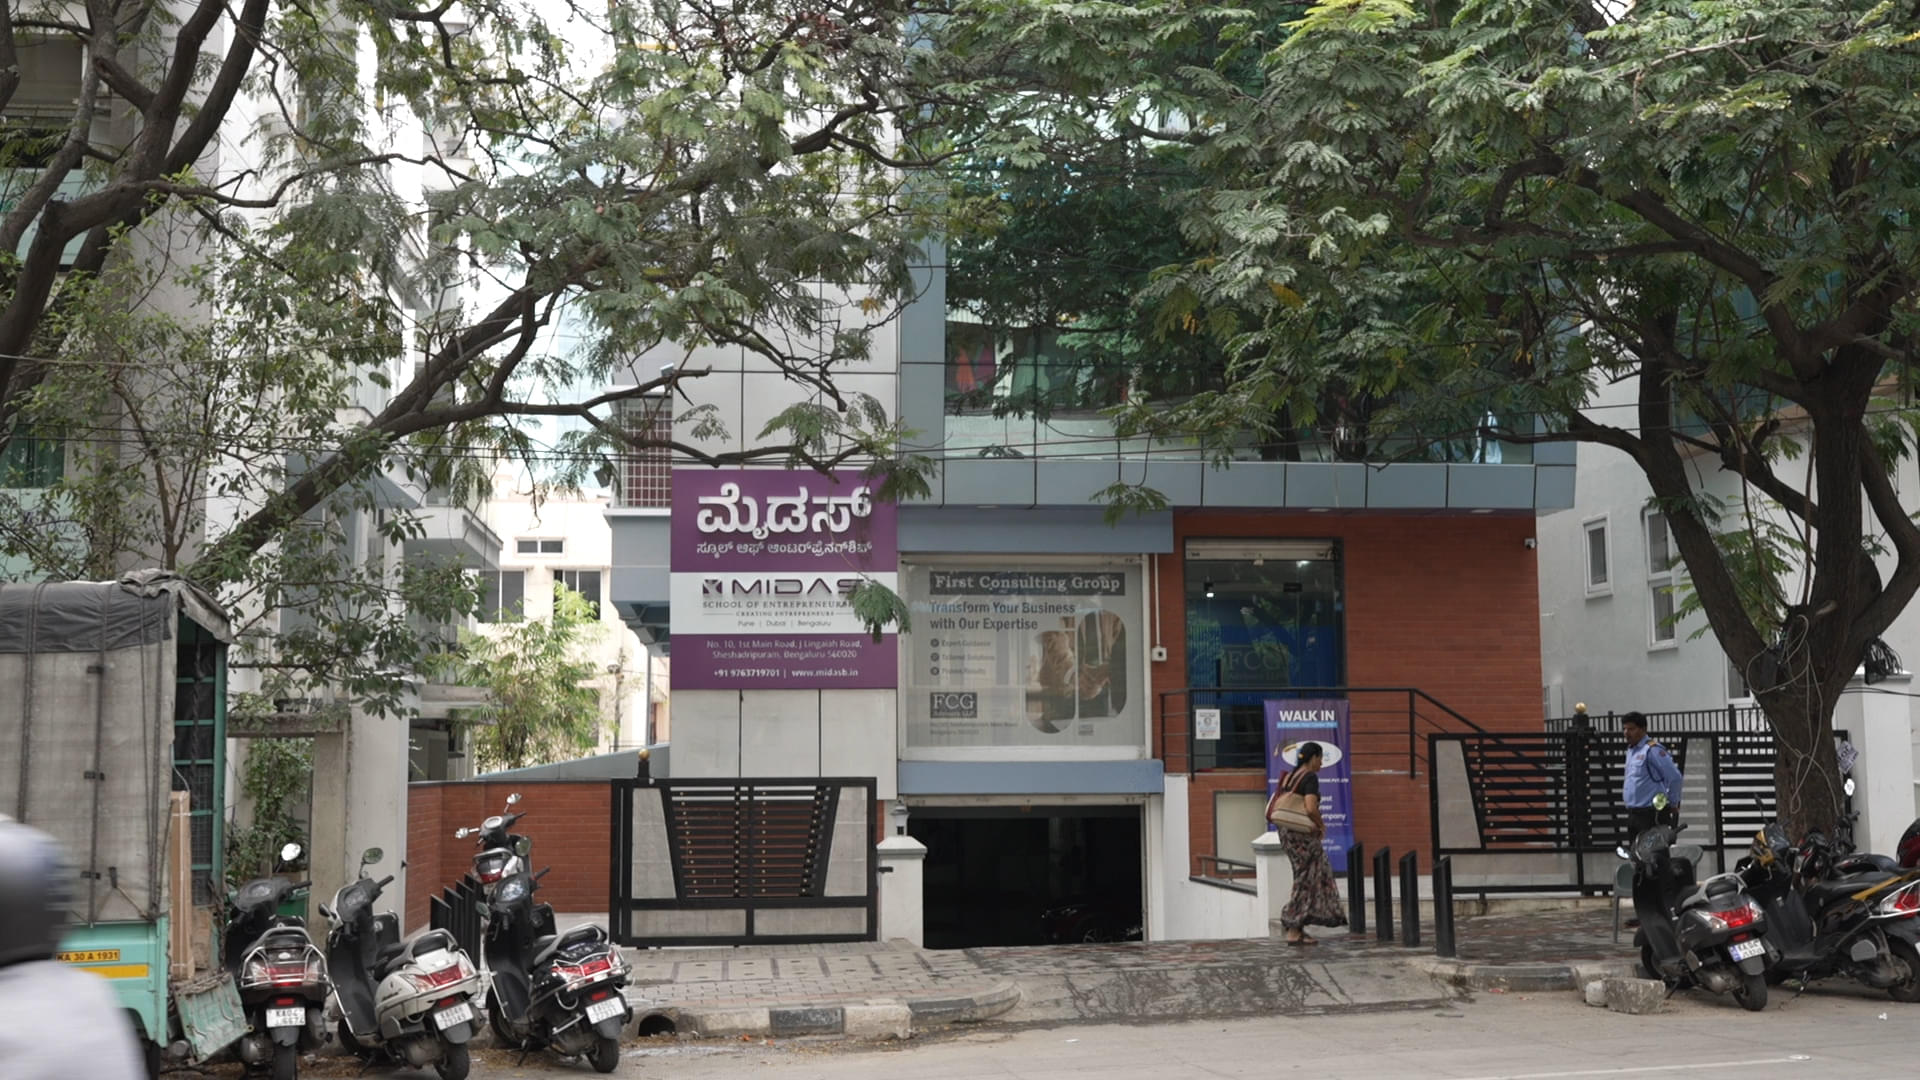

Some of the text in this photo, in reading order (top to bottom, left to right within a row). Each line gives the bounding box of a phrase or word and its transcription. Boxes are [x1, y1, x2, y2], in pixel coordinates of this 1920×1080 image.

[696, 482, 872, 539] ಮೈಡಸ್
[732, 578, 864, 594] MIDAS
[935, 575, 1120, 591] First Consulting Group
[703, 601, 743, 609] SCHOOL
[746, 601, 759, 609] OF
[930, 602, 1075, 613] Transform Your Business
[798, 620, 831, 628] Bengaluru
[930, 618, 1038, 631] with Our Expertise
[707, 640, 719, 648] No.
[739, 640, 749, 648] 1st
[752, 640, 772, 648] Main
[784, 650, 825, 660] Bengaluru
[714, 669, 728, 677] +91
[731, 669, 780, 677] 9763719701
[932, 694, 975, 710] FCG
[1280, 710, 1335, 721] WALK IN
[87, 952, 94, 960] A
[97, 951, 118, 960] 1931
